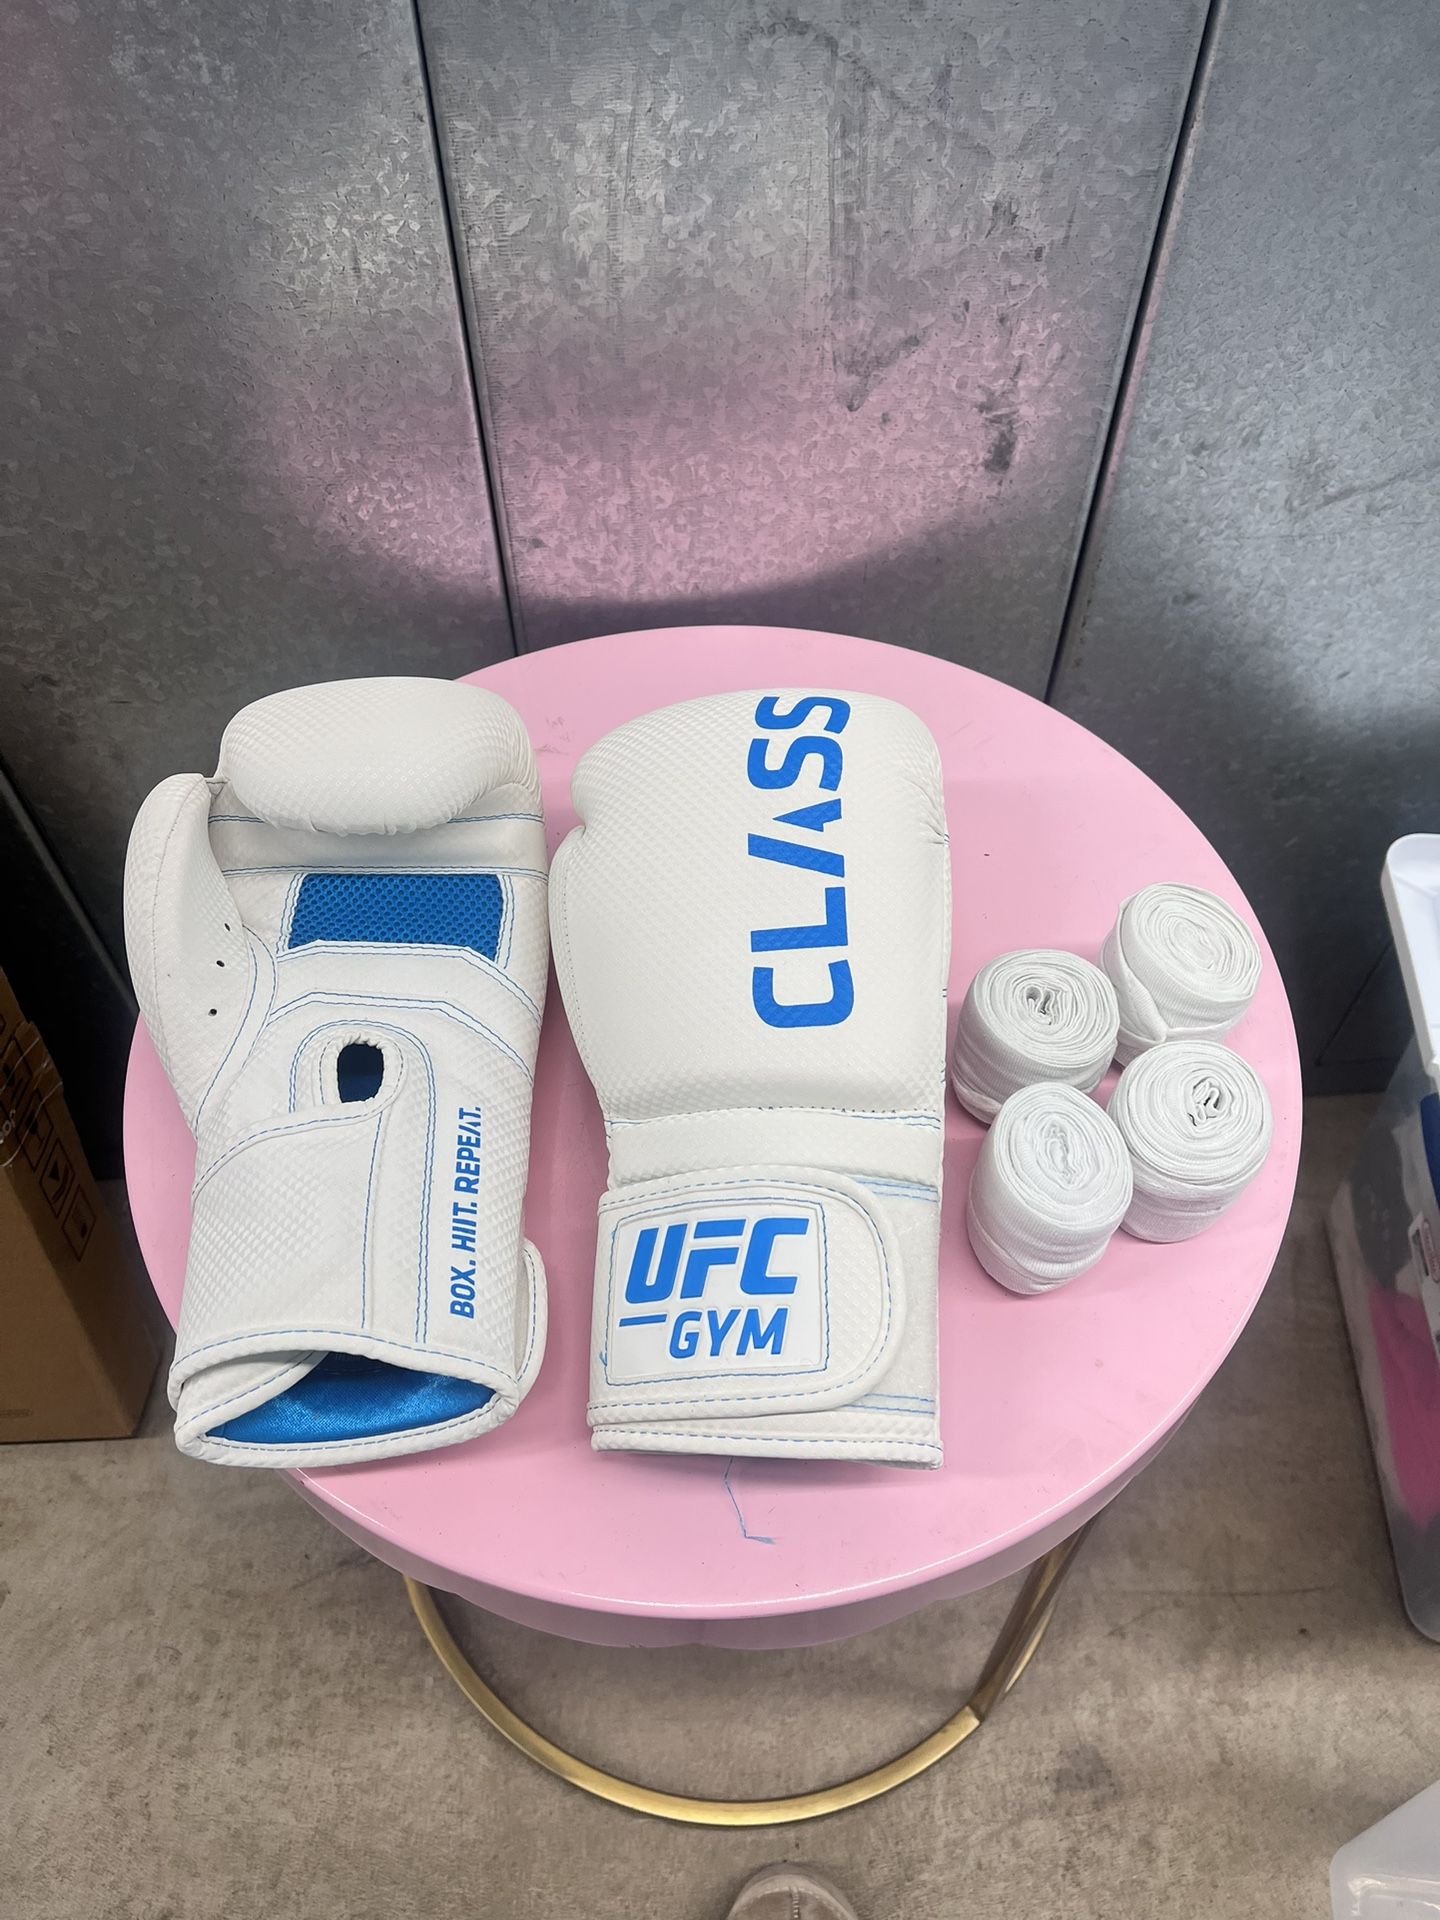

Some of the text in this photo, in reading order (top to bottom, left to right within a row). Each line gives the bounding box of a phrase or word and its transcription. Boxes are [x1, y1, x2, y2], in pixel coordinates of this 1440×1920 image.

[747, 696, 854, 1029] CLASS
[450, 1106, 481, 1319] BOX. HIIT. REPEAT.
[625, 1217, 809, 1305] UFC
[669, 1307, 789, 1359] GYM
